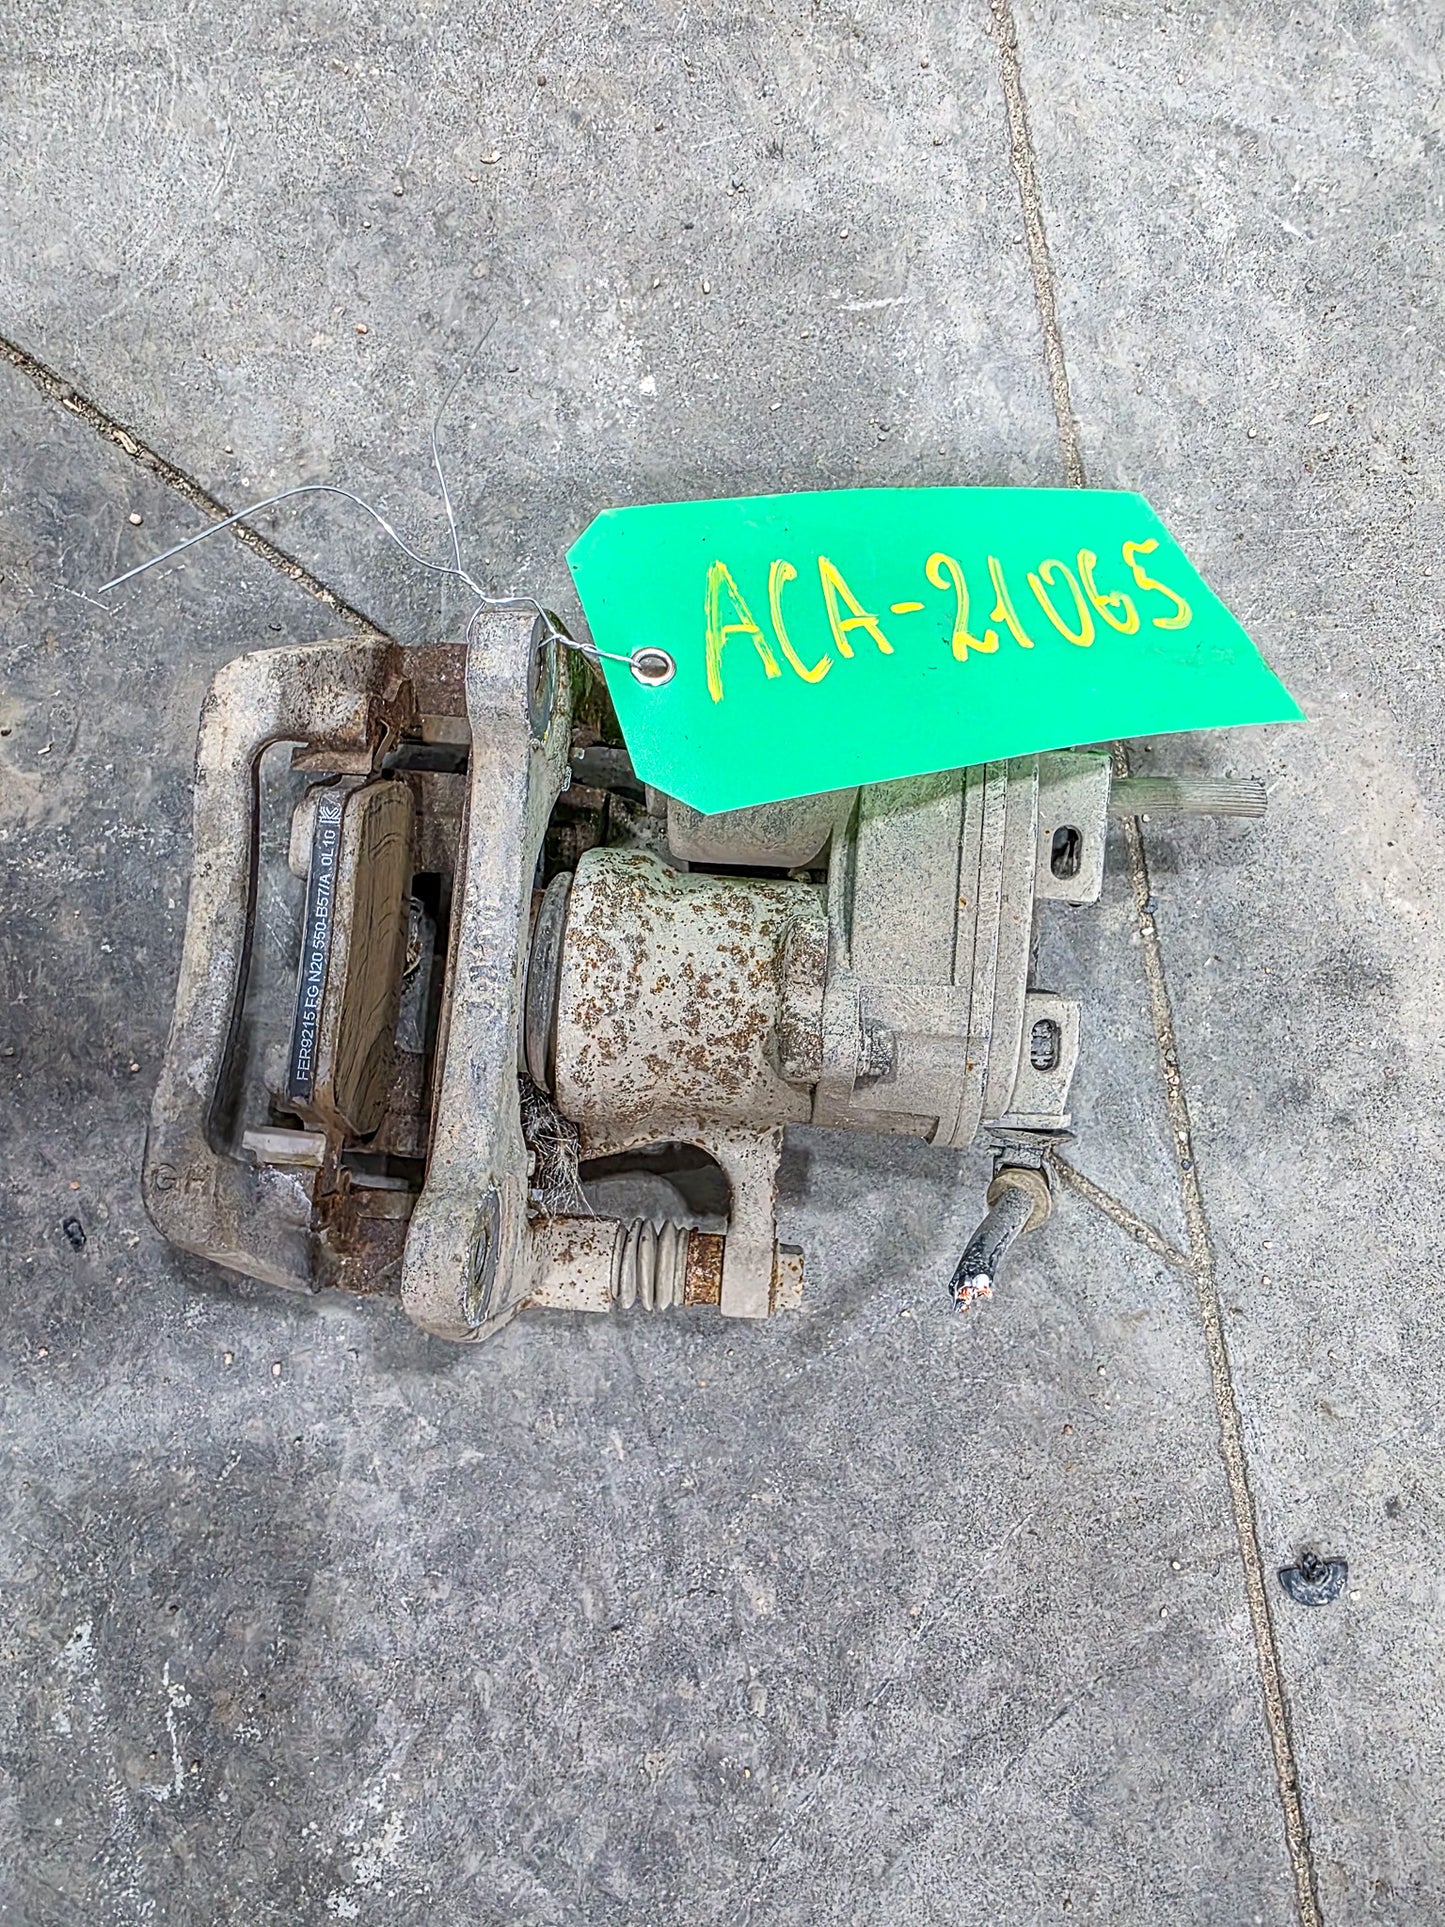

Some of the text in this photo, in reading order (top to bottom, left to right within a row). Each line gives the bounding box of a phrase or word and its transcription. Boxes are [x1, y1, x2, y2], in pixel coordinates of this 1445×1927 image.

[703, 538, 1192, 704] ACA-21065
[312, 873, 331, 950] 550-B57/A
[308, 952, 324, 982] N20
[296, 1011, 316, 1081] FER9215
